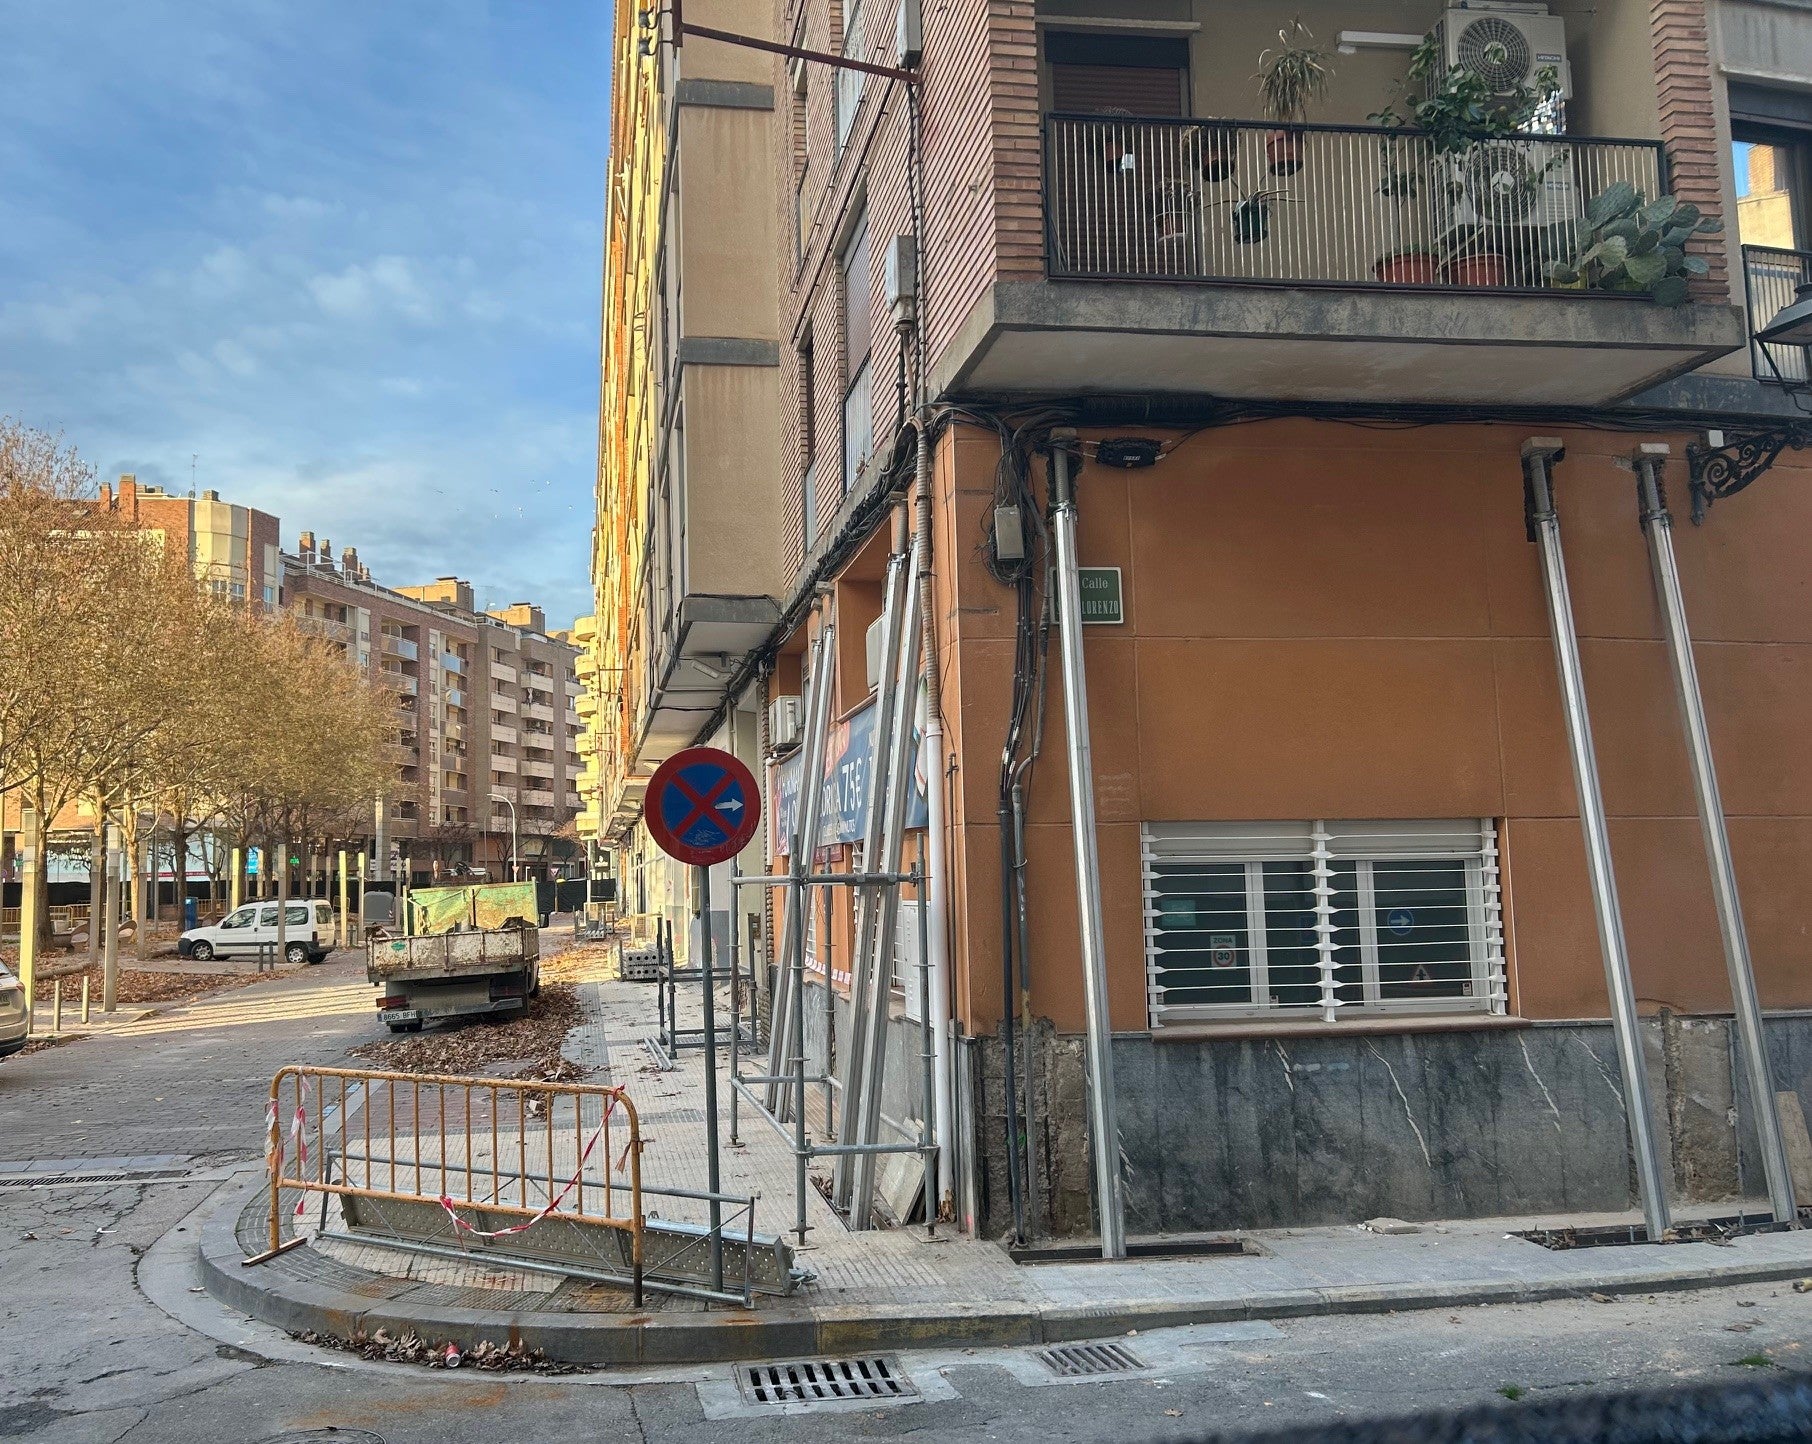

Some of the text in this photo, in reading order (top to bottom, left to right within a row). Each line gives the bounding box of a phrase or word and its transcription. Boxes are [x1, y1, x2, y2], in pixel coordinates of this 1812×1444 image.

[1082, 577, 1108, 589] Calle
[1081, 600, 1119, 615] LORENZO
[842, 757, 862, 813] 75€
[1212, 936, 1233, 944] ZONA
[1217, 952, 1230, 961] 30
